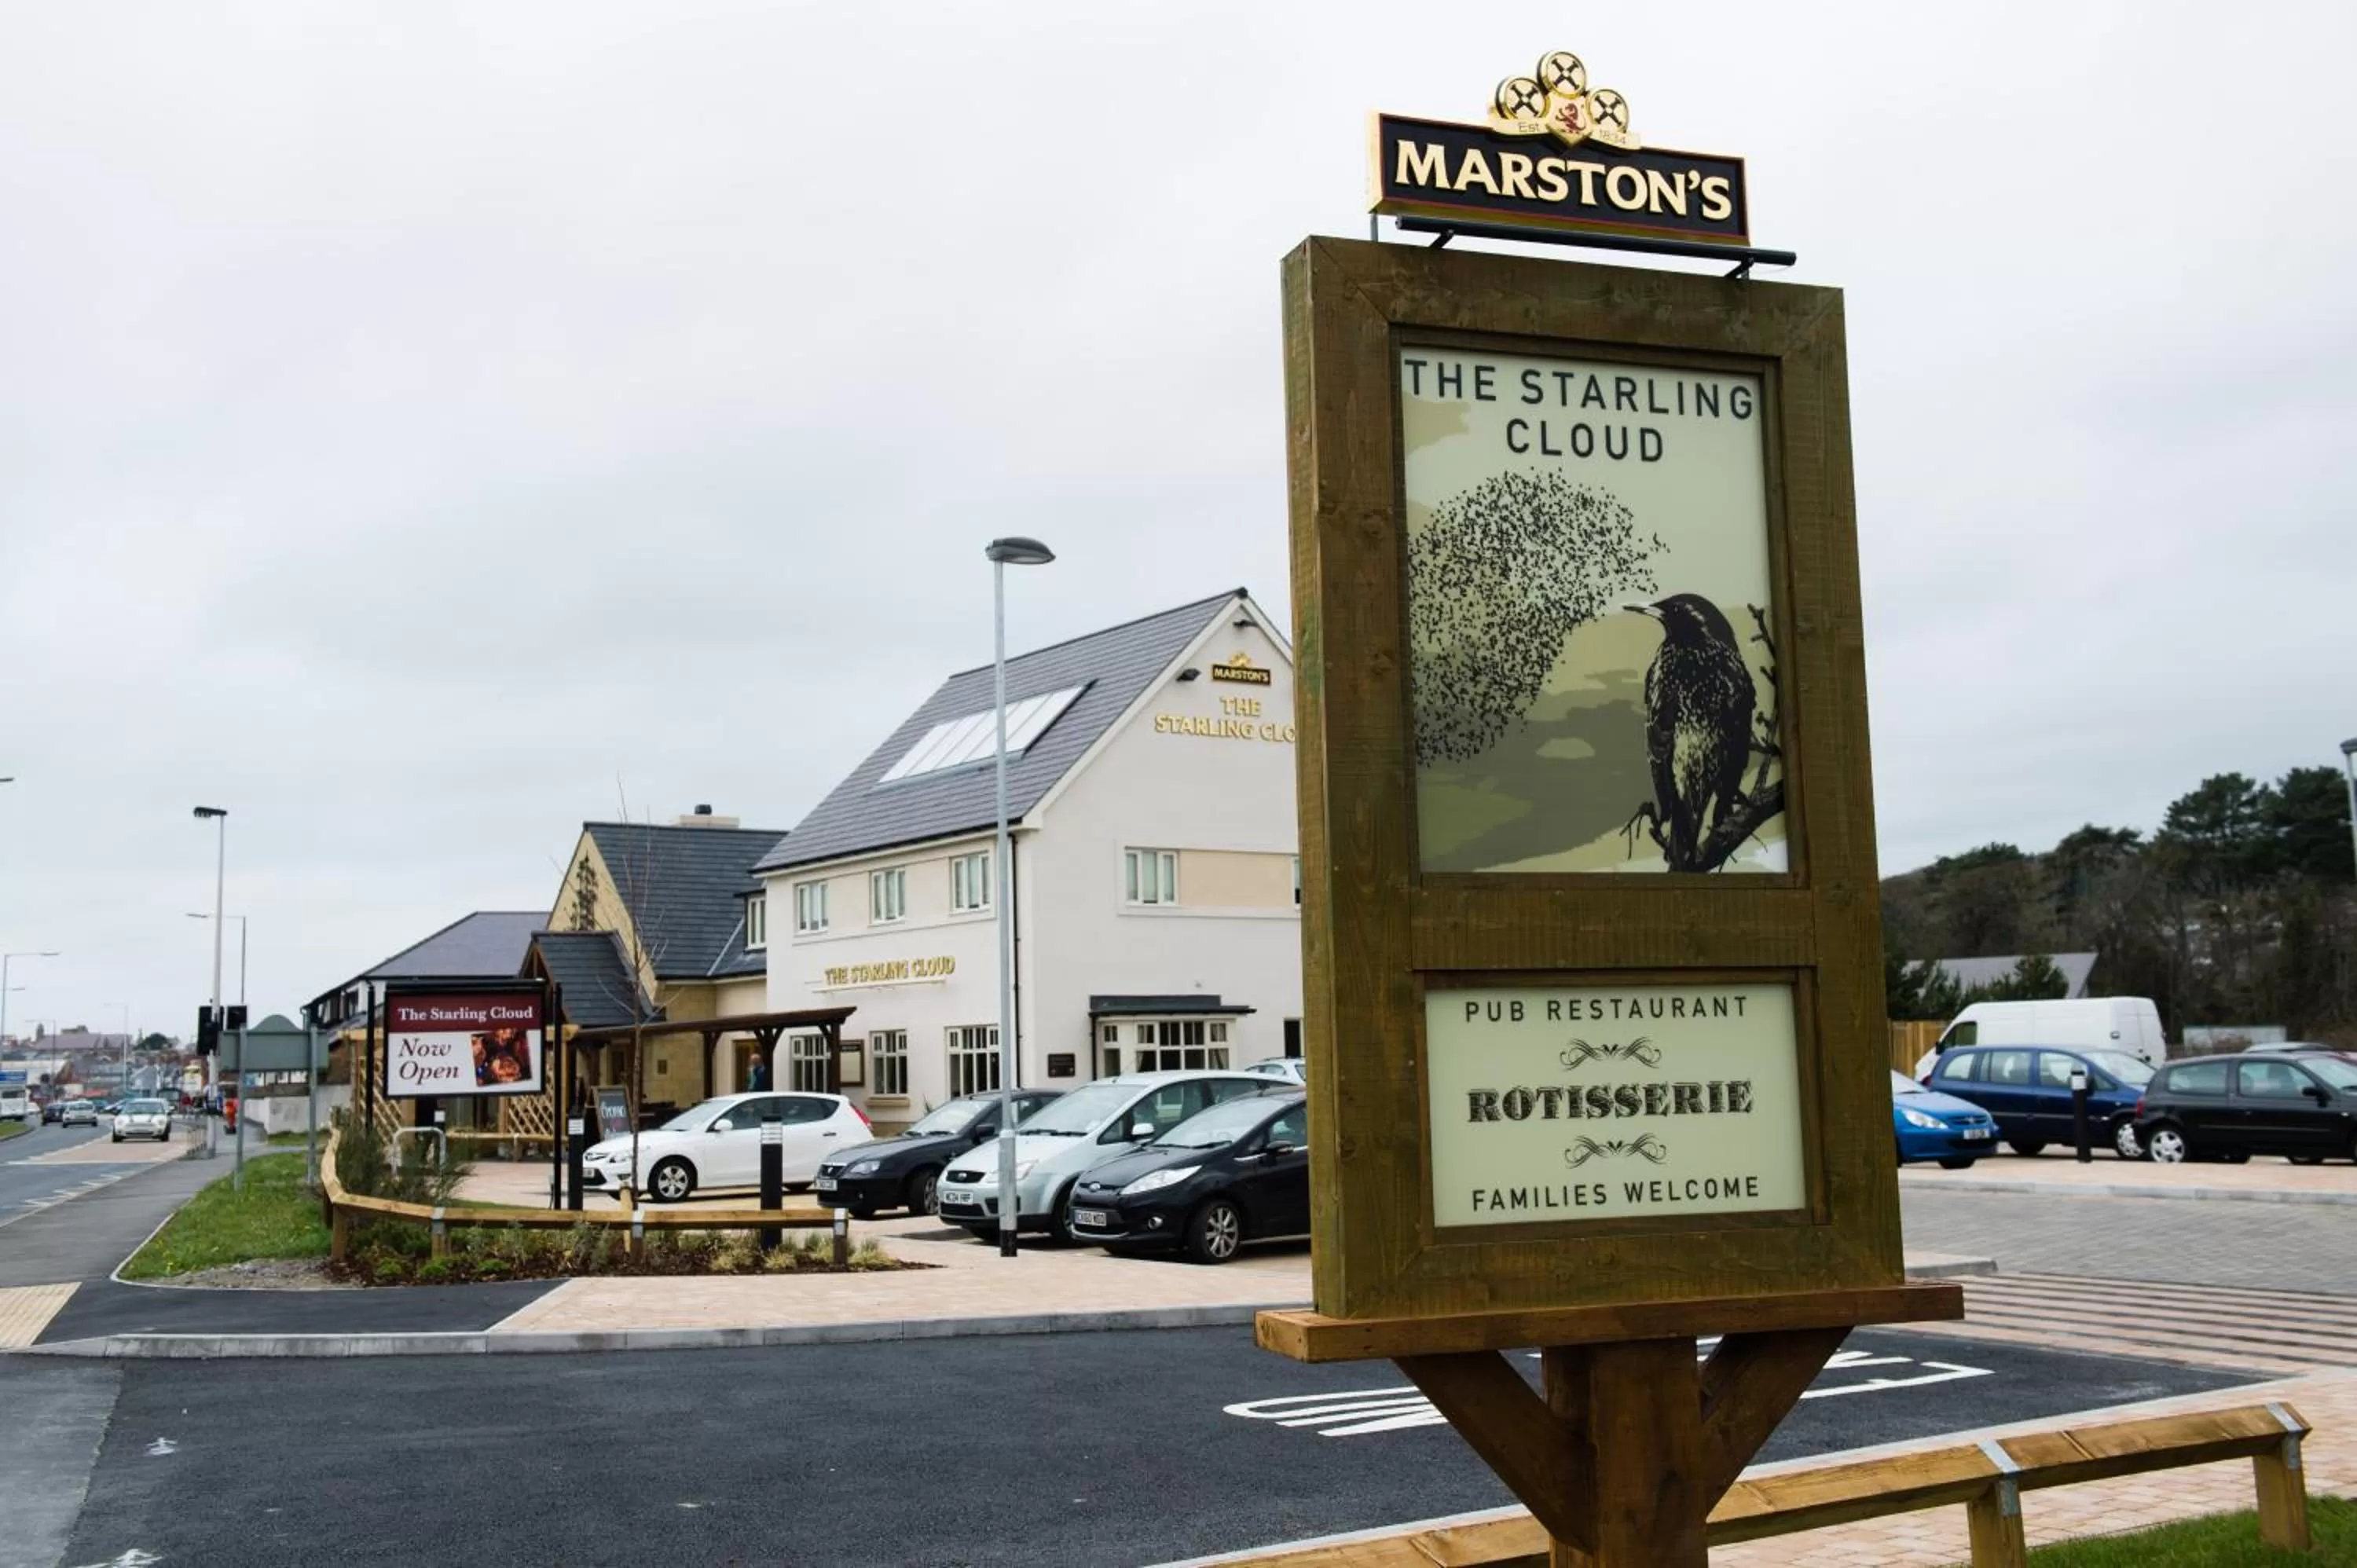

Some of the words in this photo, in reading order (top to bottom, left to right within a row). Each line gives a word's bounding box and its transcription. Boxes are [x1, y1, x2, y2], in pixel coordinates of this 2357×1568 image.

[1518, 121, 1541, 133] Est
[1395, 139, 1732, 222] MARSTON'S
[1404, 359, 1497, 402] THE
[1520, 368, 1753, 419] STARLING
[1506, 418, 1663, 462] CLOUD
[1214, 668, 1270, 683] MARSTON'S
[1220, 697, 1261, 716] THE
[1155, 714, 1254, 739] STARLING
[1259, 721, 1295, 742] CLO
[825, 966, 849, 985] THE
[852, 960, 909, 983] STARLING
[911, 954, 955, 977] CLOUD
[398, 1007, 427, 1020] The
[430, 1007, 487, 1023] Starling
[489, 1006, 533, 1019] Cloud
[1465, 1001, 1525, 1023] PUB
[1547, 996, 1748, 1020] RESTAURANT
[398, 1037, 452, 1058] Now
[399, 1061, 460, 1086] Open
[1466, 1079, 1753, 1123] ROTISSERIE
[1472, 1184, 1607, 1211] FAMILIES
[1624, 1176, 1760, 1203] WELCOME
